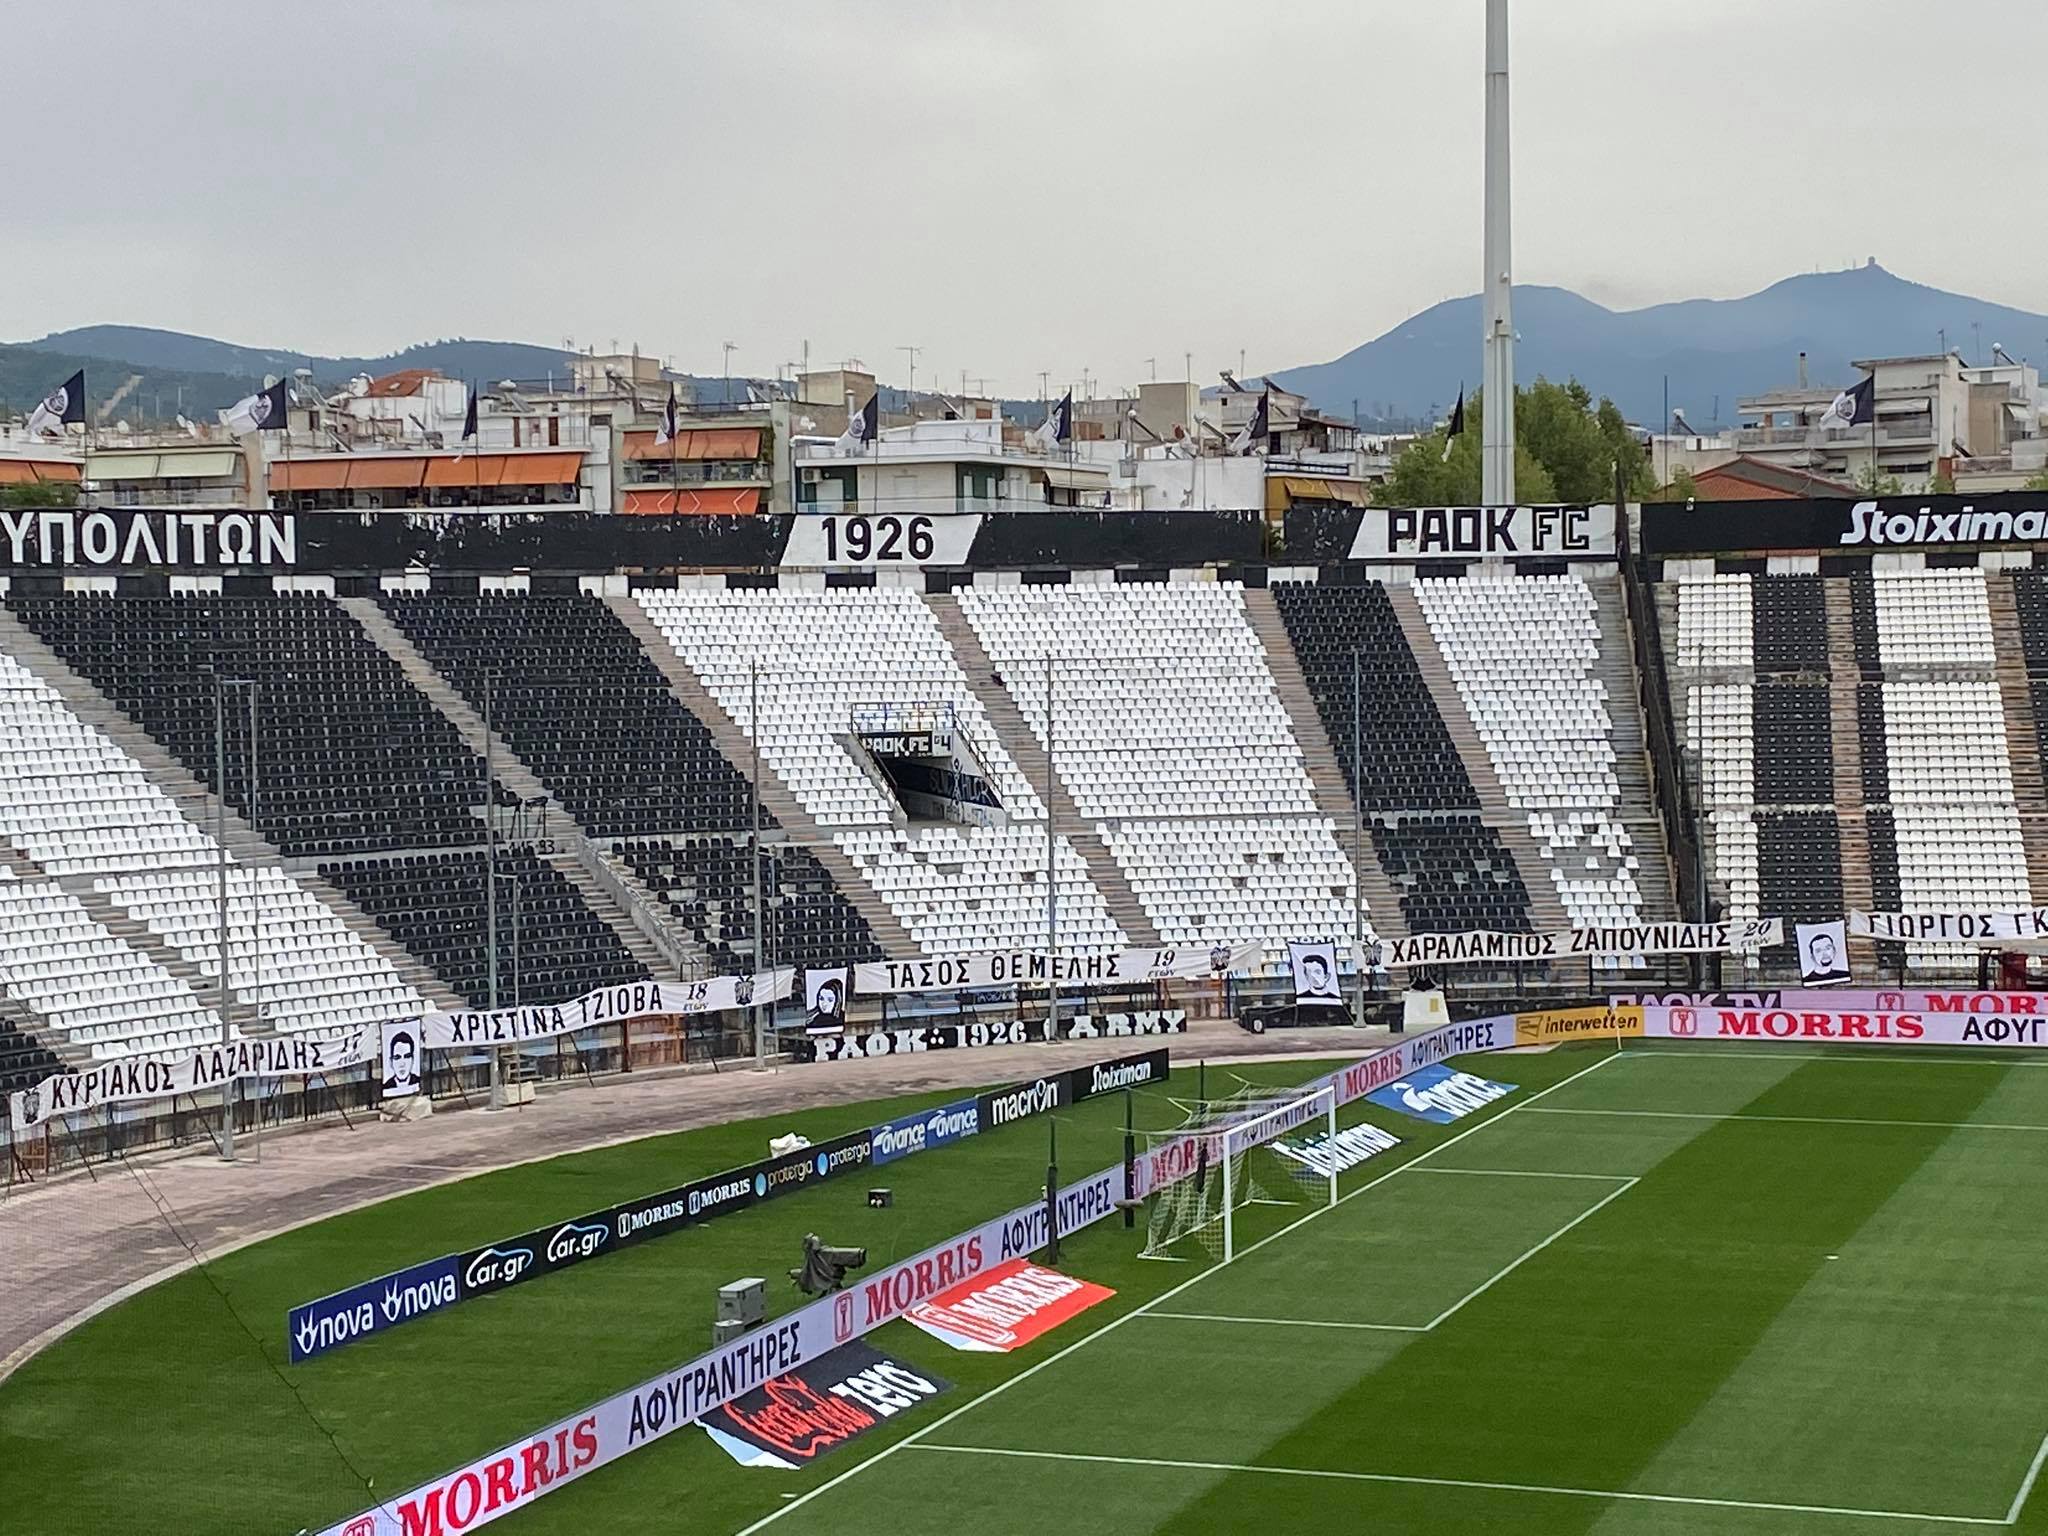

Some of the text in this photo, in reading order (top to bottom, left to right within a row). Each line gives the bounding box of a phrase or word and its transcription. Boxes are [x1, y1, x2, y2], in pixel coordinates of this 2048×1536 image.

[822, 516, 934, 561] 1926
[1388, 506, 1590, 553] PAOK FC
[1839, 501, 2048, 544] Stoixima
[1391, 920, 1772, 963] ΧΑΡΑΛΑΜΠΟΣ ΖΑΠΟΥΝΙΔΗΣ 20
[1867, 913, 1995, 938] ΓΙΩΡΓΟΣ
[885, 949, 1176, 989] ΤΑΣΟΣ ΘΕΜΕΛΗΣ 19
[450, 982, 709, 1043] ΧΡΙΣΤΙΝΑ ΤΖΙΟΒΑ 18
[1544, 1011, 1638, 1034] interwetten
[1717, 1011, 1924, 1038] MORRIS
[813, 1009, 1187, 1062] PAOK 1926 ARMY
[51, 1061, 175, 1109] ΚΥΡΙΑΚΟΣ
[193, 1040, 324, 1086] ΛΑΖΑΡΙΔΗΣ
[1090, 1060, 1151, 1094] Stoiximan
[1344, 1050, 1403, 1098] MORRIS
[991, 1079, 1059, 1125] macron
[632, 1200, 684, 1230] MORRIS
[700, 1178, 751, 1208] MORRIS
[547, 1223, 609, 1262] Car.gr
[1001, 1178, 1111, 1262] ΑΦΥΓΡΝΤΗΡΕΣ
[465, 1248, 534, 1288] Car.gr
[865, 1235, 983, 1326] MORRIS
[404, 1273, 457, 1317] nova
[947, 1266, 1085, 1330] MORRIS
[320, 1301, 374, 1348] nova
[628, 1320, 801, 1446] ΑΦΥΓΡΑΝΤΗΡΕΣ
[397, 1415, 599, 1536] MORRIS
